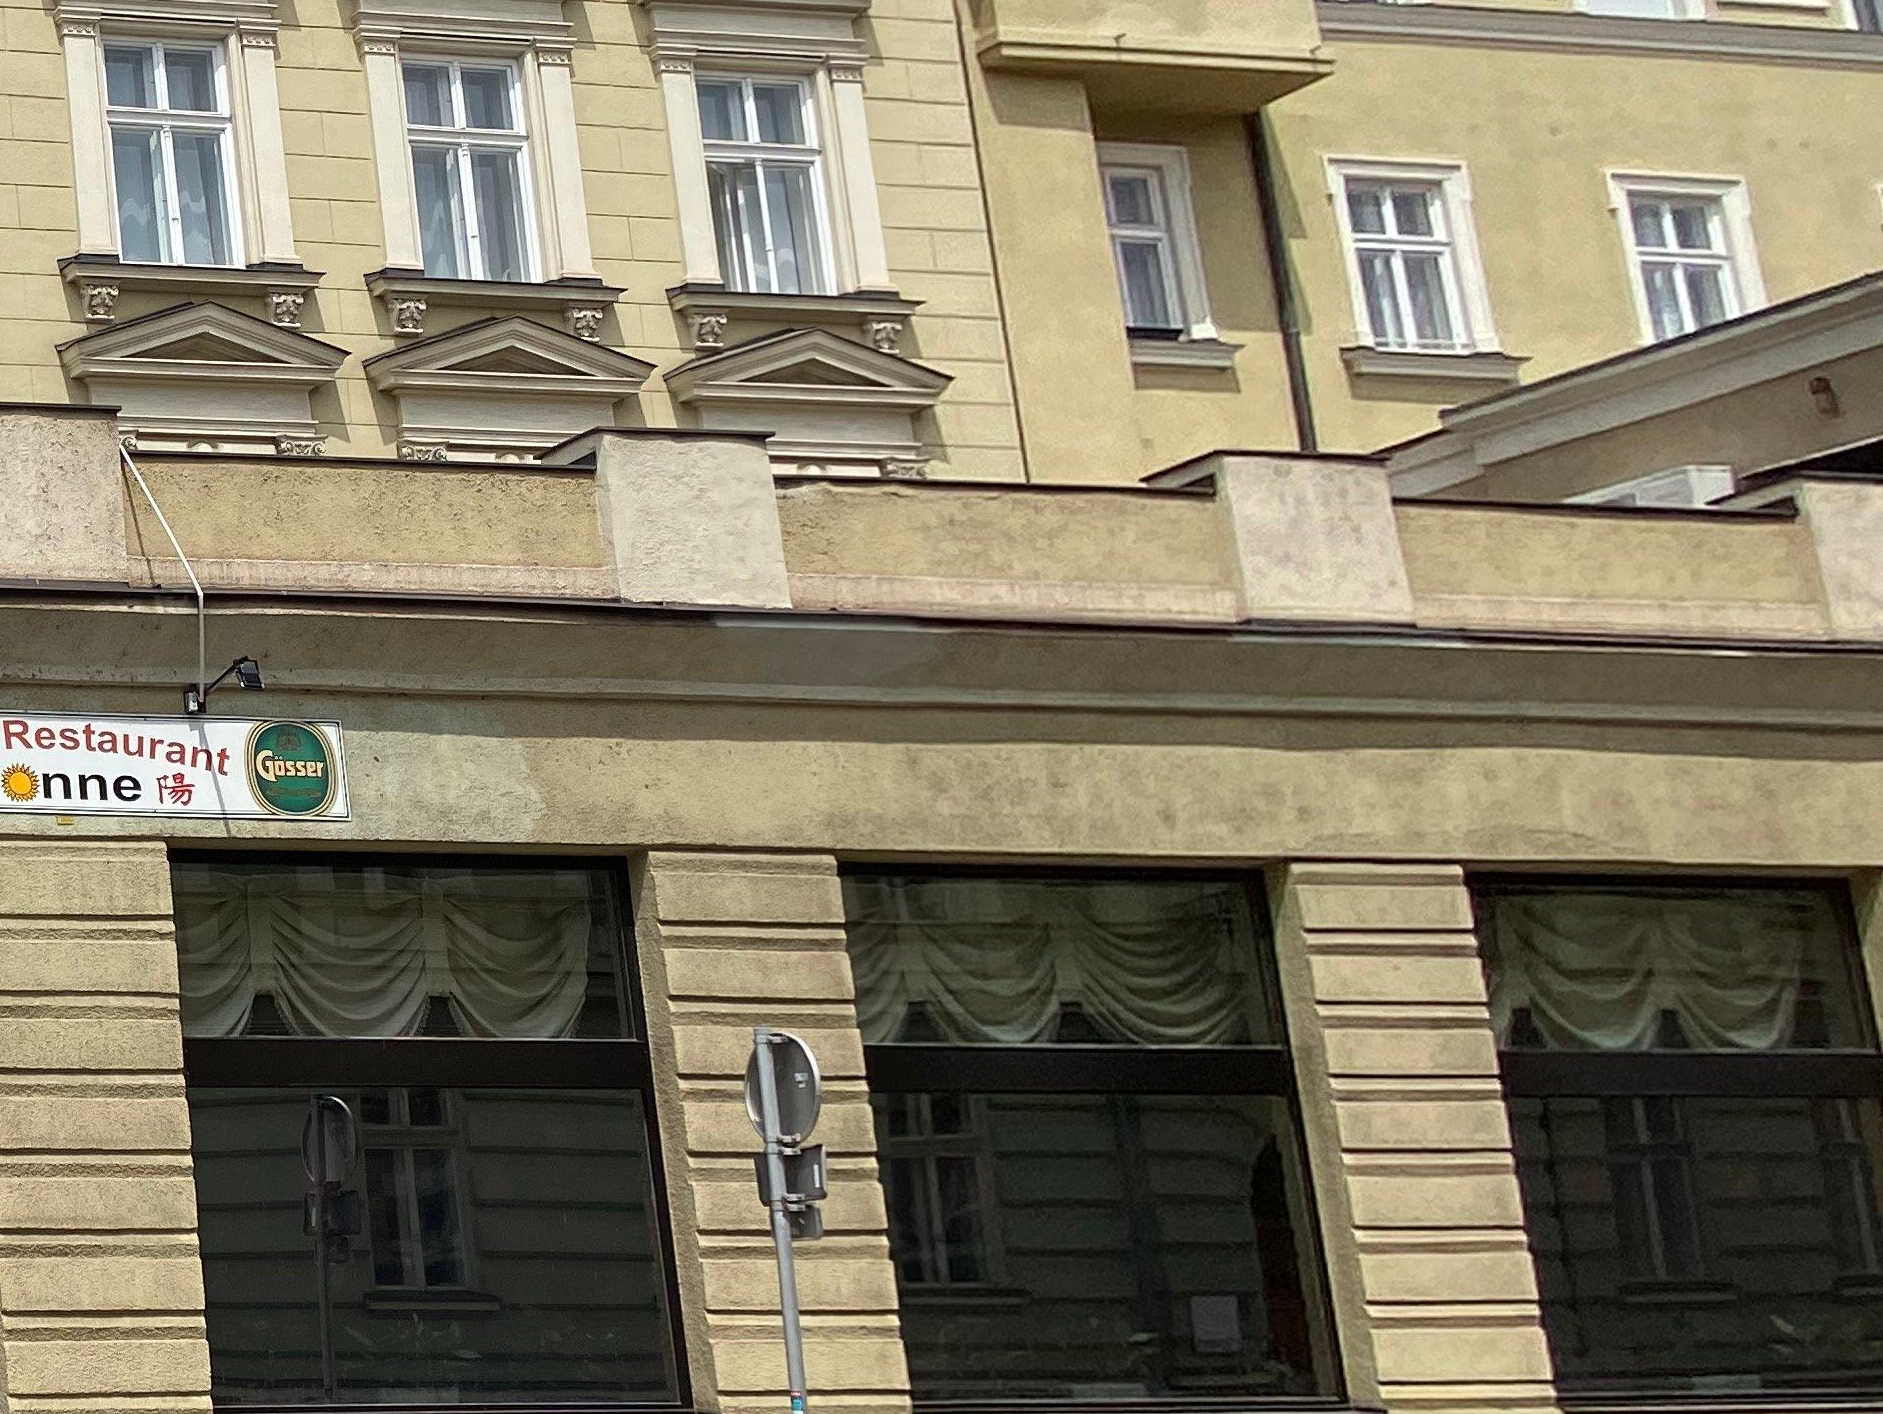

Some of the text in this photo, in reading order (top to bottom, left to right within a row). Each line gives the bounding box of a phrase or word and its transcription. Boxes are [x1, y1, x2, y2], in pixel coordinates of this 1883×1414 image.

[2, 719, 231, 777] Restaurant
[255, 749, 324, 782] Gösser
[155, 772, 196, 807] 陽
